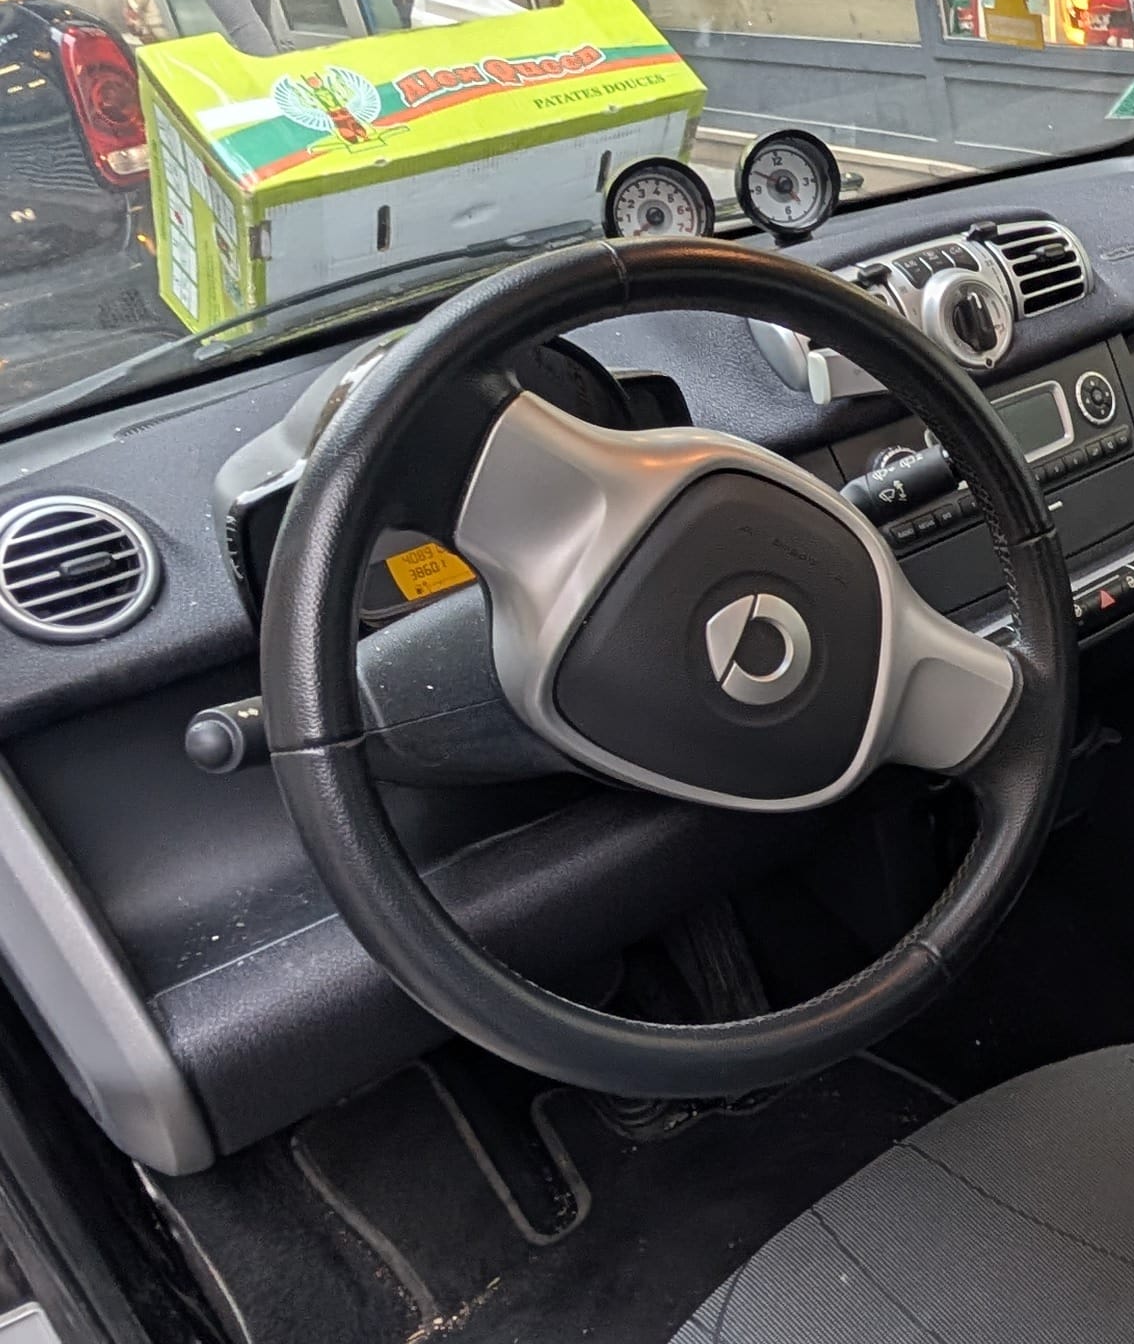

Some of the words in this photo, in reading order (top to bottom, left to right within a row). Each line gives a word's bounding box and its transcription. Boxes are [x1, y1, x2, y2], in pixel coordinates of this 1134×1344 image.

[396, 66, 486, 106] Alex
[483, 45, 602, 84] Queen
[532, 86, 603, 110] PATATES
[604, 73, 666, 95] DOUCES
